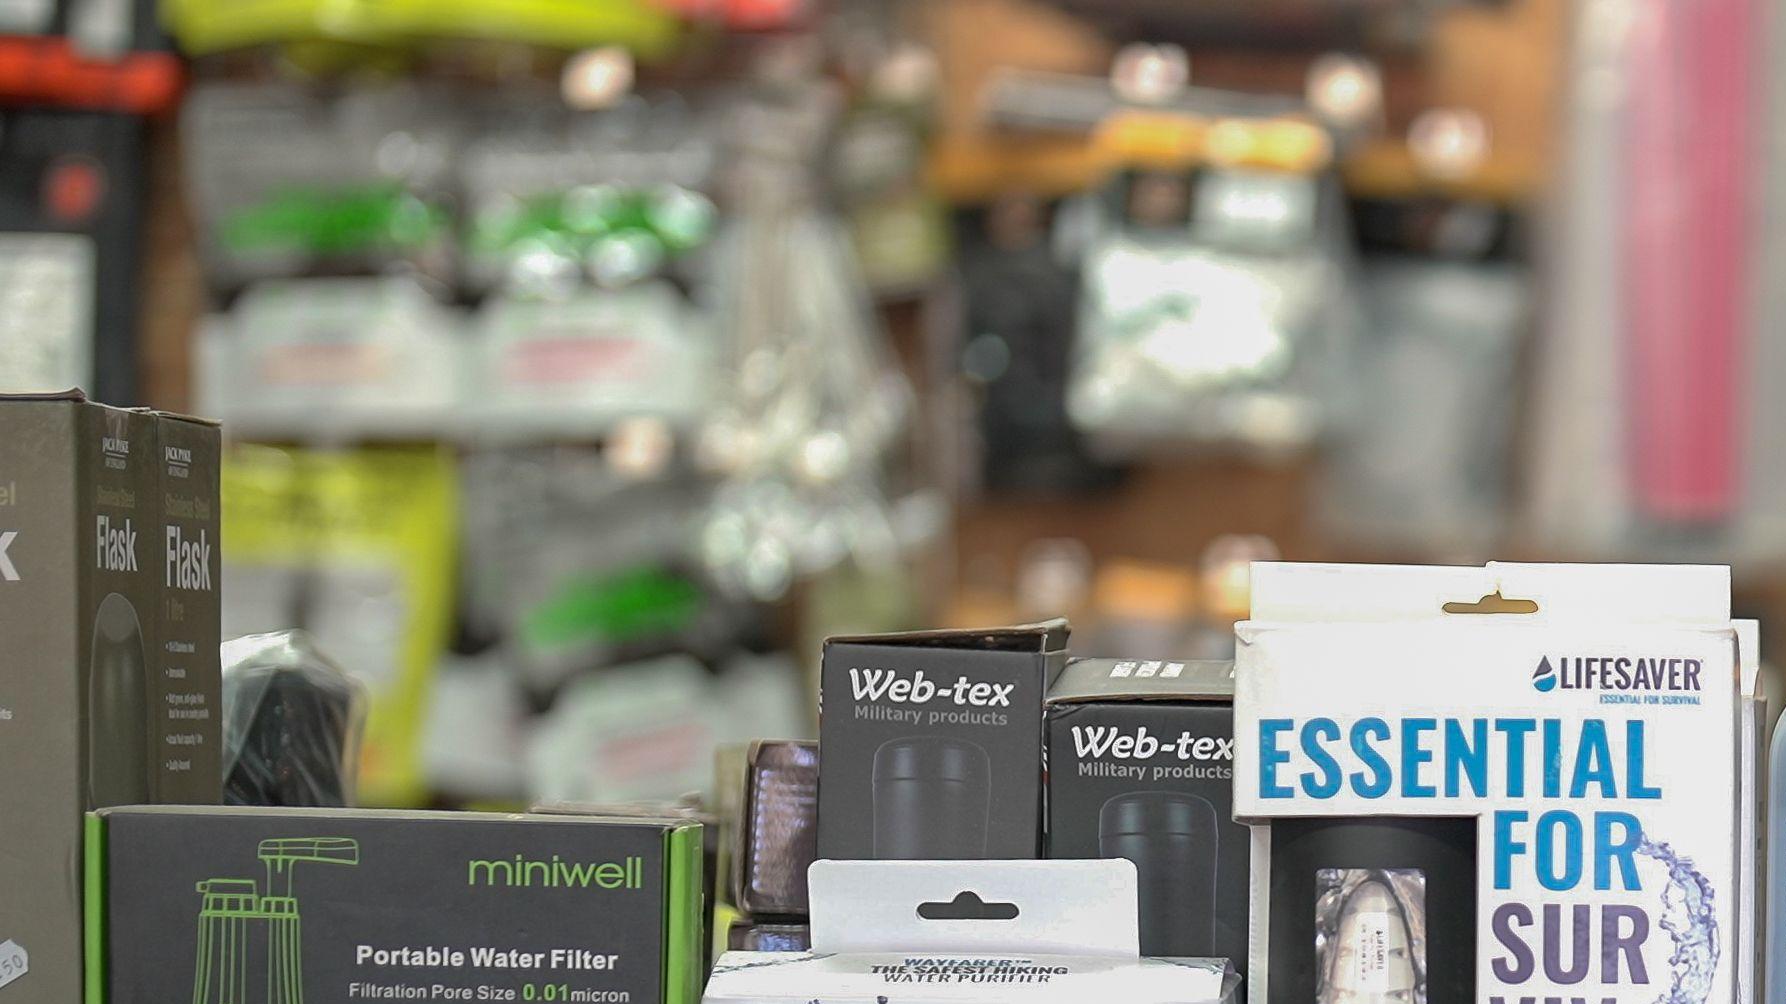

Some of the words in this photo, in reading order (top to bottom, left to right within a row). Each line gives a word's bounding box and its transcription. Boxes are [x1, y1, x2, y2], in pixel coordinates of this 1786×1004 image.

[97, 515, 138, 571] Flask
[167, 525, 211, 591] Flask
[849, 668, 1014, 707] Web-tex
[1560, 657, 1702, 691] LIFESAVER
[854, 705, 922, 725] Military
[928, 707, 1008, 727] products
[1072, 725, 1234, 760] Web-tex
[1259, 718, 1662, 800] ESSENTIAL
[1078, 762, 1146, 782] Military
[1155, 763, 1232, 782] products
[1494, 810, 1642, 891] FOR
[468, 855, 643, 889] miniwell
[356, 944, 464, 968] Portable
[470, 947, 544, 970] Water
[550, 949, 618, 971] Filter
[1491, 903, 1650, 985] SUR
[871, 965, 907, 974] THE
[914, 965, 988, 975] SAFEST
[994, 966, 1069, 975] HIKING
[884, 974, 950, 983] WATER
[957, 974, 1052, 983] PURIFIER
[348, 983, 426, 1001] Filtration
[431, 984, 472, 1001] Pore
[477, 984, 515, 1002] Size
